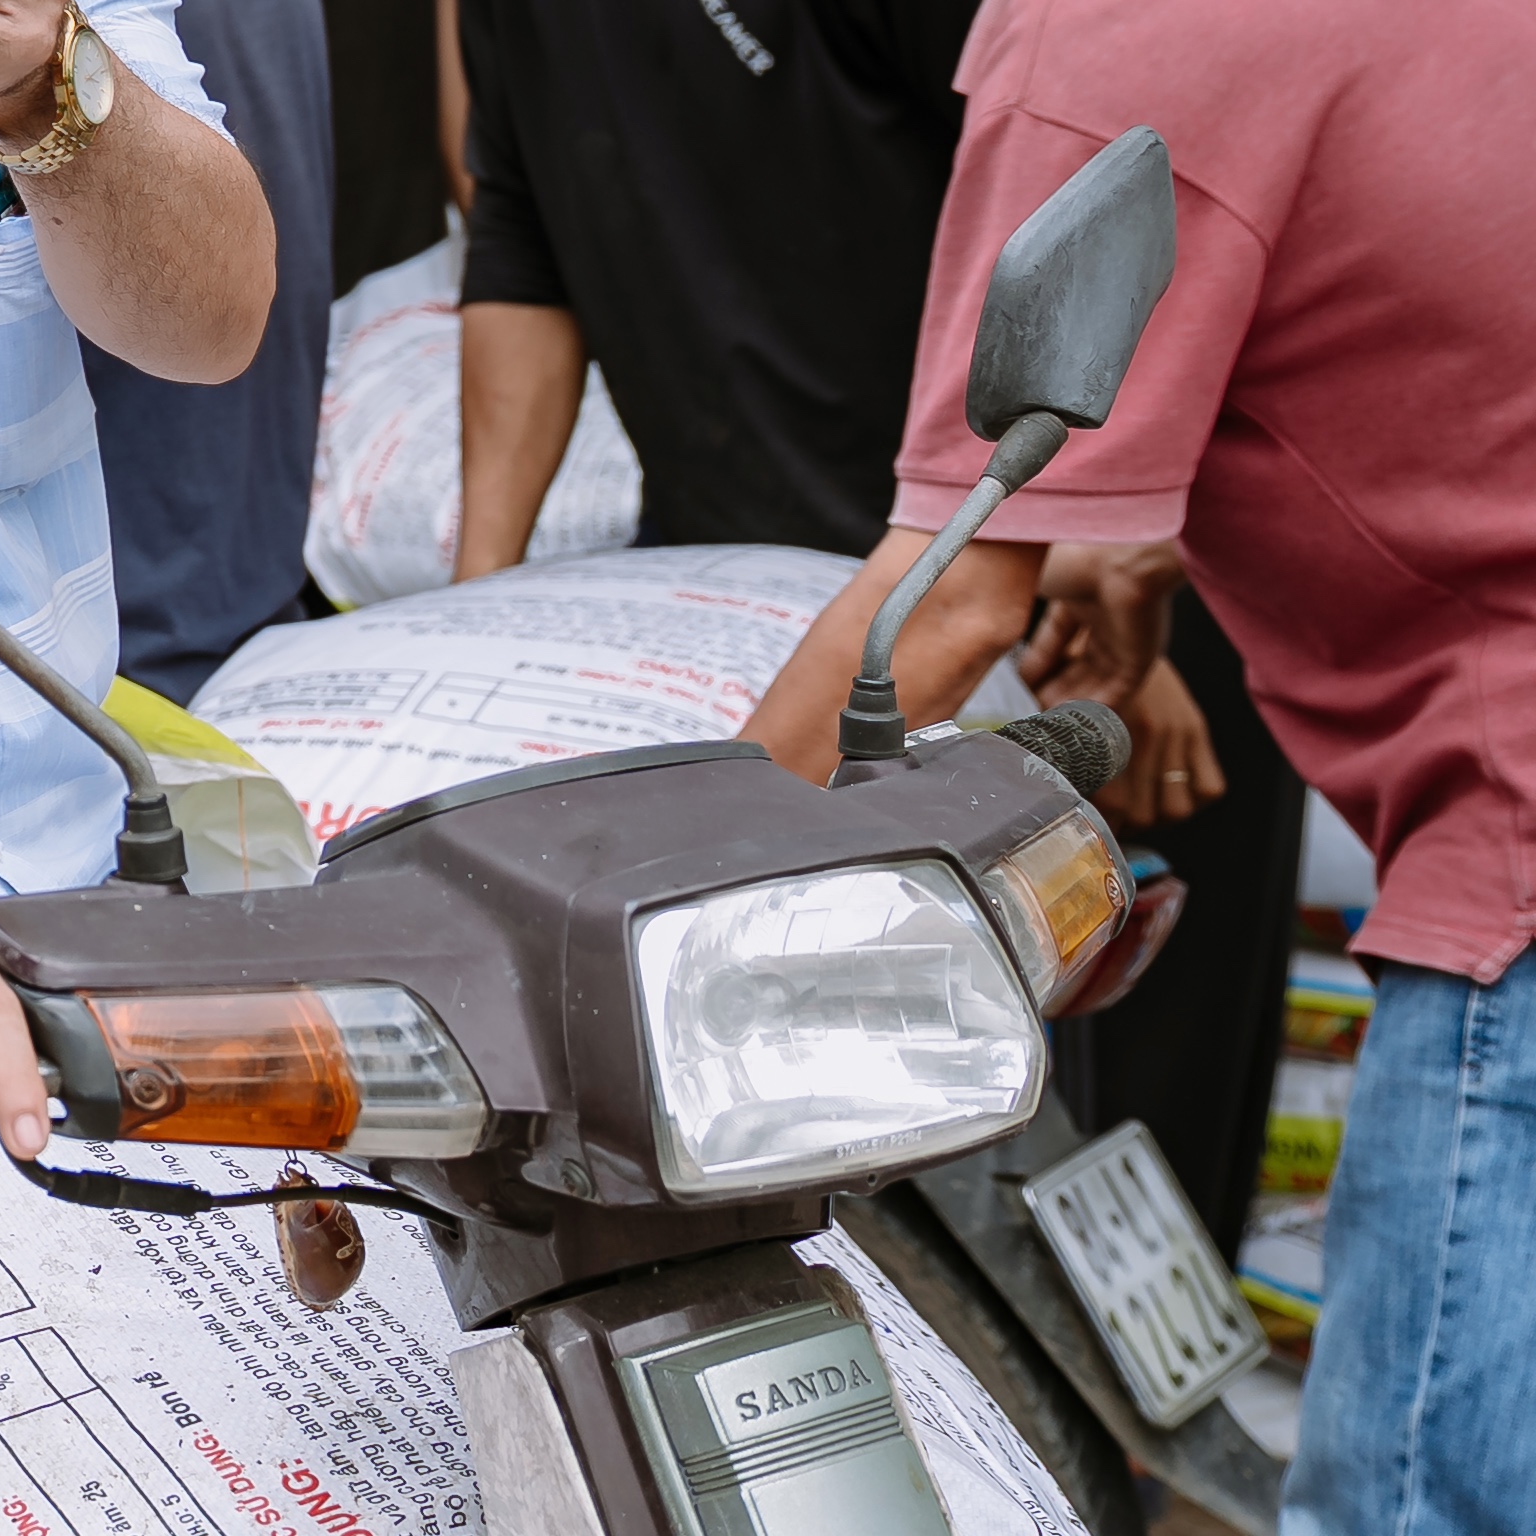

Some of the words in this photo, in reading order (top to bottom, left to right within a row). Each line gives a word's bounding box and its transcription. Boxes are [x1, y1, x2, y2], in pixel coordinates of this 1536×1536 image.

[143, 1207, 172, 1231] có
[133, 1238, 169, 1266] xốp
[164, 1234, 215, 1282] dưỡng
[231, 1230, 264, 1260] kéo
[208, 1282, 246, 1317] dinh
[246, 1288, 299, 1335] xanh,
[353, 1285, 406, 1335] chuẩn
[198, 1313, 247, 1352] nhiêu
[235, 1319, 279, 1349] chất
[284, 1326, 313, 1348] lá
[326, 1328, 377, 1374] giảm
[344, 1316, 392, 1355] nông
[400, 1332, 439, 1371] tiêu
[234, 1354, 278, 1379] phì
[274, 1351, 308, 1379] các
[307, 1346, 361, 1401] mạnh,
[383, 1356, 436, 1403] lượng
[160, 1390, 203, 1428] Bón
[261, 1381, 292, 1404] độ
[735, 1358, 873, 1423] SANDA
[284, 1403, 328, 1440] tăng
[328, 1409, 367, 1443] hấp
[346, 1392, 396, 1435] triển
[400, 1401, 436, 1442] cho
[194, 1434, 254, 1494] DỤNG:
[359, 1441, 415, 1498] cường
[386, 1432, 439, 1476] phát
[426, 1436, 476, 1482] sống
[79, 1480, 107, 1501] 25
[159, 1494, 180, 1507] 5
[237, 1496, 280, 1525] SỬ
[443, 1494, 470, 1529] bộ
